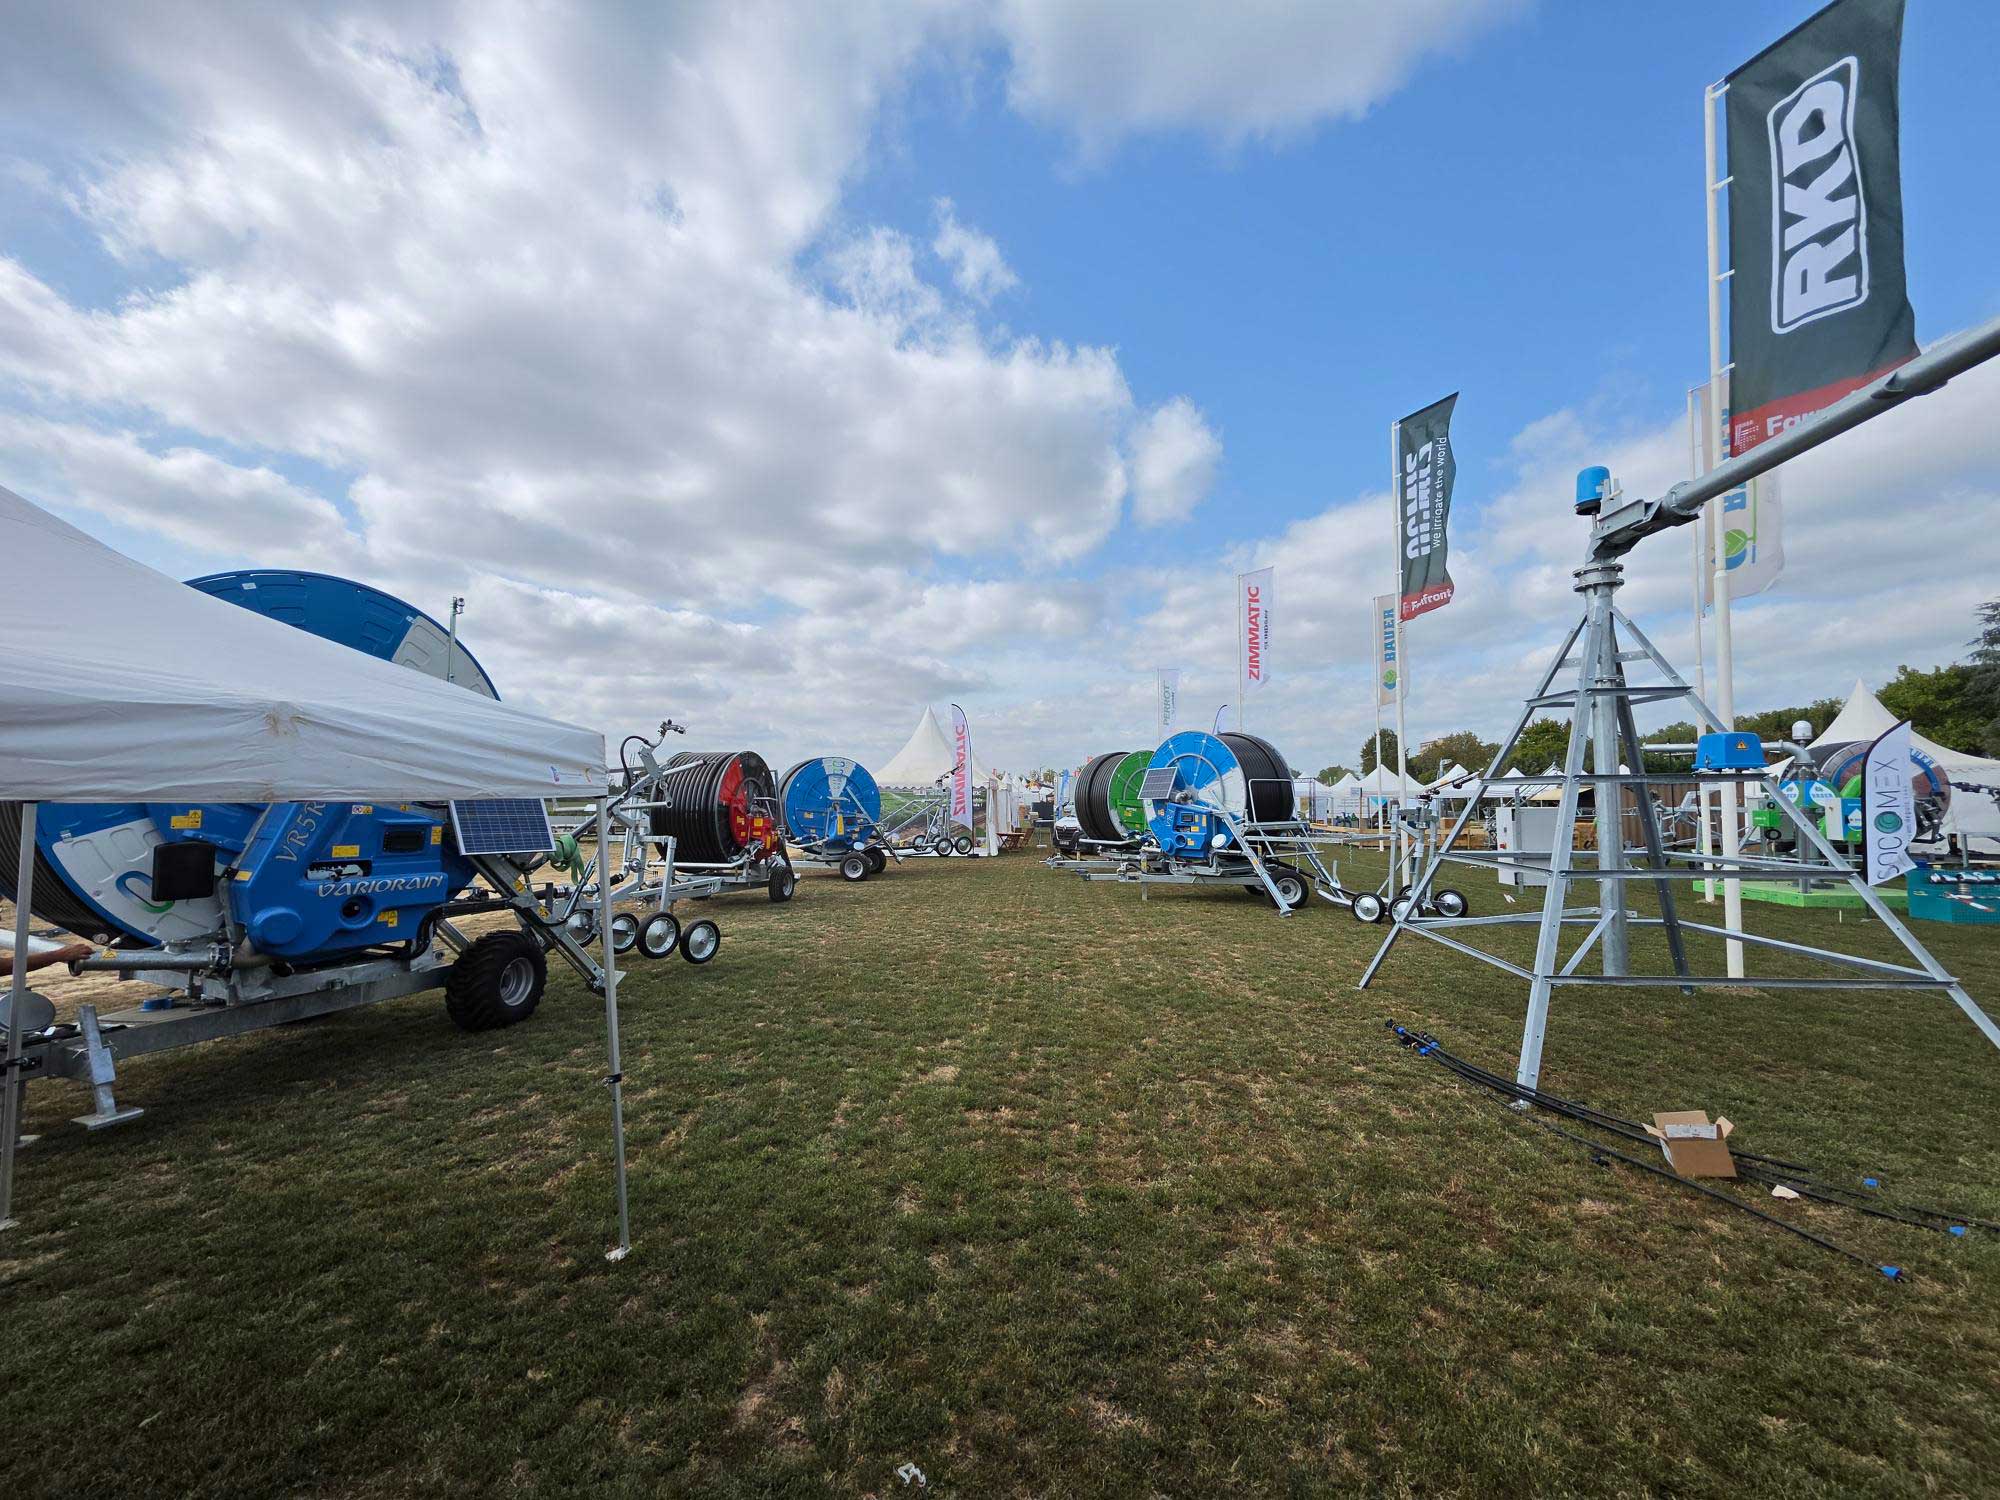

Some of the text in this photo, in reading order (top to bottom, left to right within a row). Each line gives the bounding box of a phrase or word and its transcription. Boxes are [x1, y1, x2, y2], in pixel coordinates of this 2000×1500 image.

[1779, 80, 1857, 324] RKD
[1431, 437, 1447, 549] we irrigate the world
[1248, 586, 1260, 681] ZIMMATIC
[1384, 608, 1396, 662] BAUER
[1873, 758, 1903, 880] SOCOMEX
[318, 875, 443, 898] VARIORAIN
